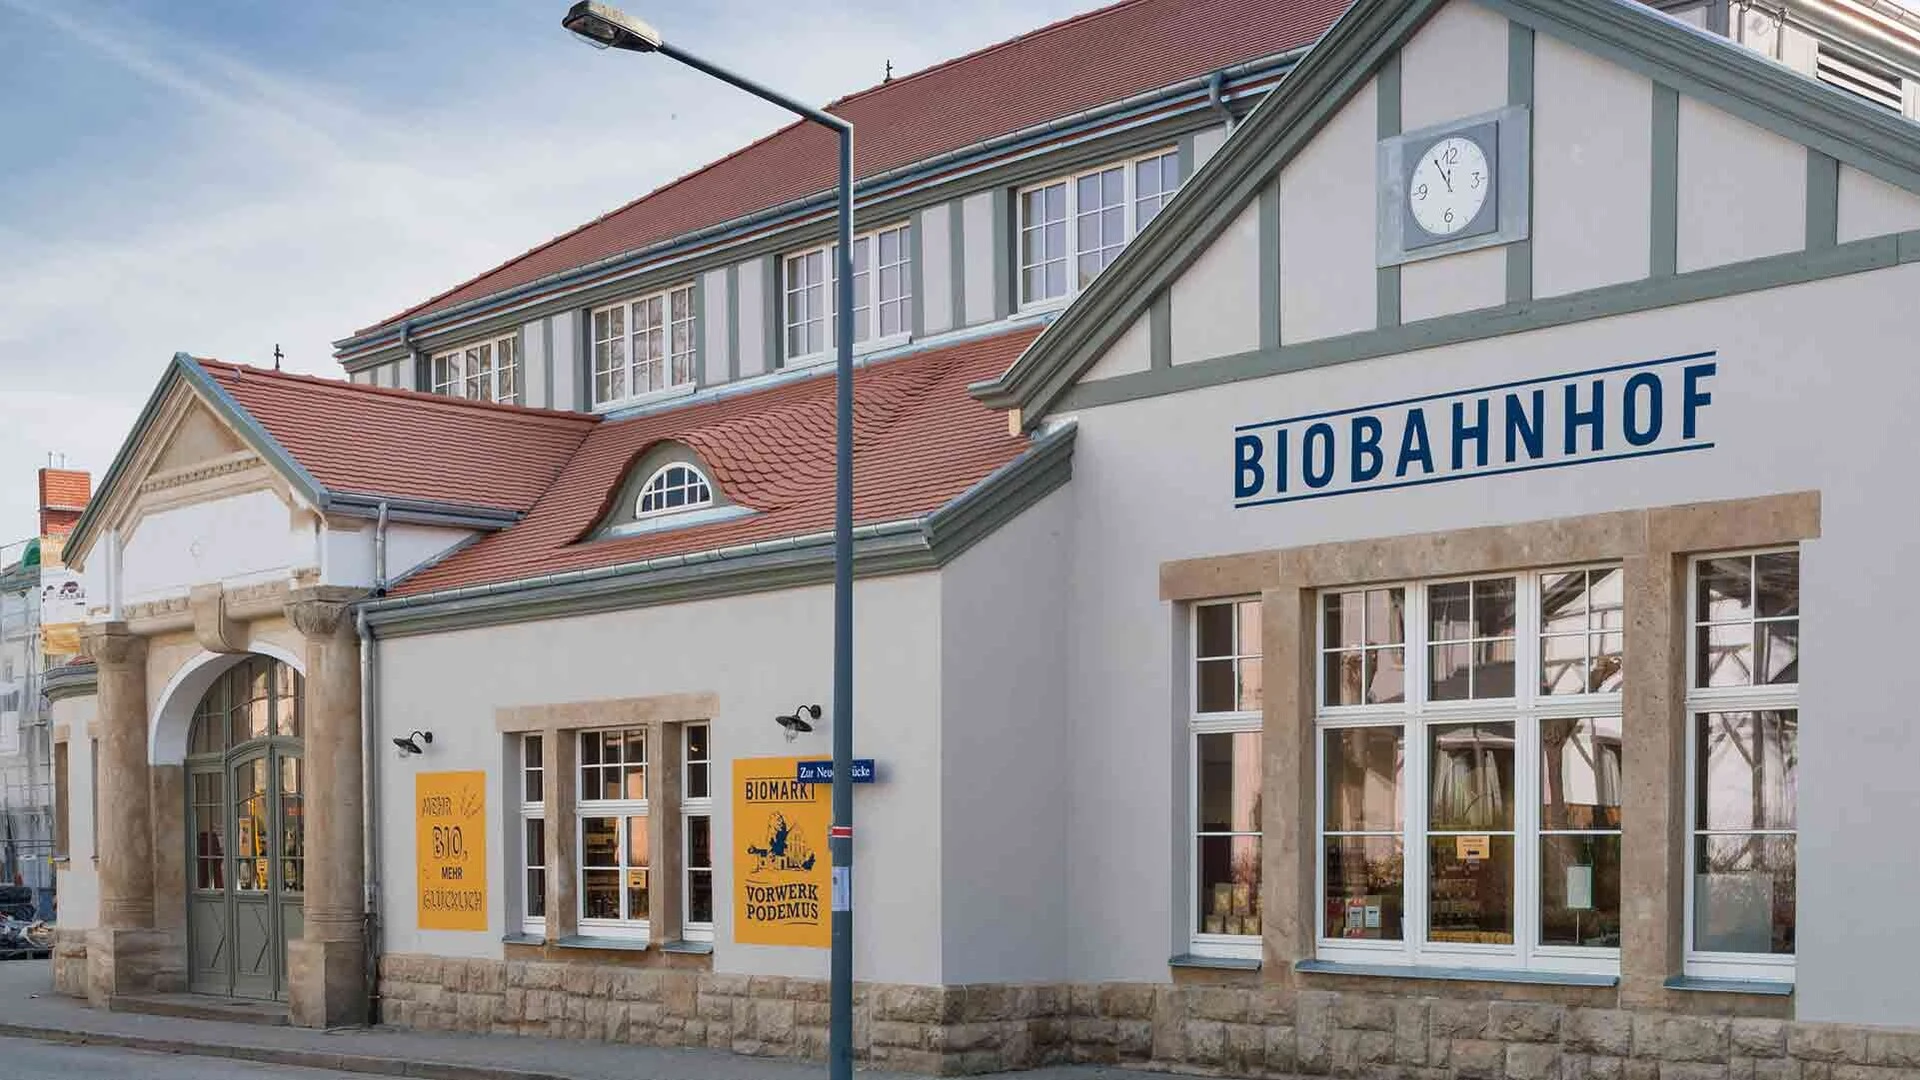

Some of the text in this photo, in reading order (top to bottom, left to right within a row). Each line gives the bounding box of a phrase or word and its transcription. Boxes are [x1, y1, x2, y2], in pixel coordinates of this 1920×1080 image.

[1442, 148, 1458, 164] 12
[1471, 171, 1480, 189] 3
[1418, 183, 1428, 201] 9
[1444, 207, 1454, 223] 6
[1234, 363, 1717, 498] BIOBAHNHOF
[800, 764, 871, 779] Zur Neu ücke
[745, 780, 815, 800] BIOMARKT
[433, 825, 468, 861] BIO,
[441, 866, 463, 880] MEHR
[745, 883, 819, 903] VORWERK
[747, 902, 819, 921] PODEMUS
